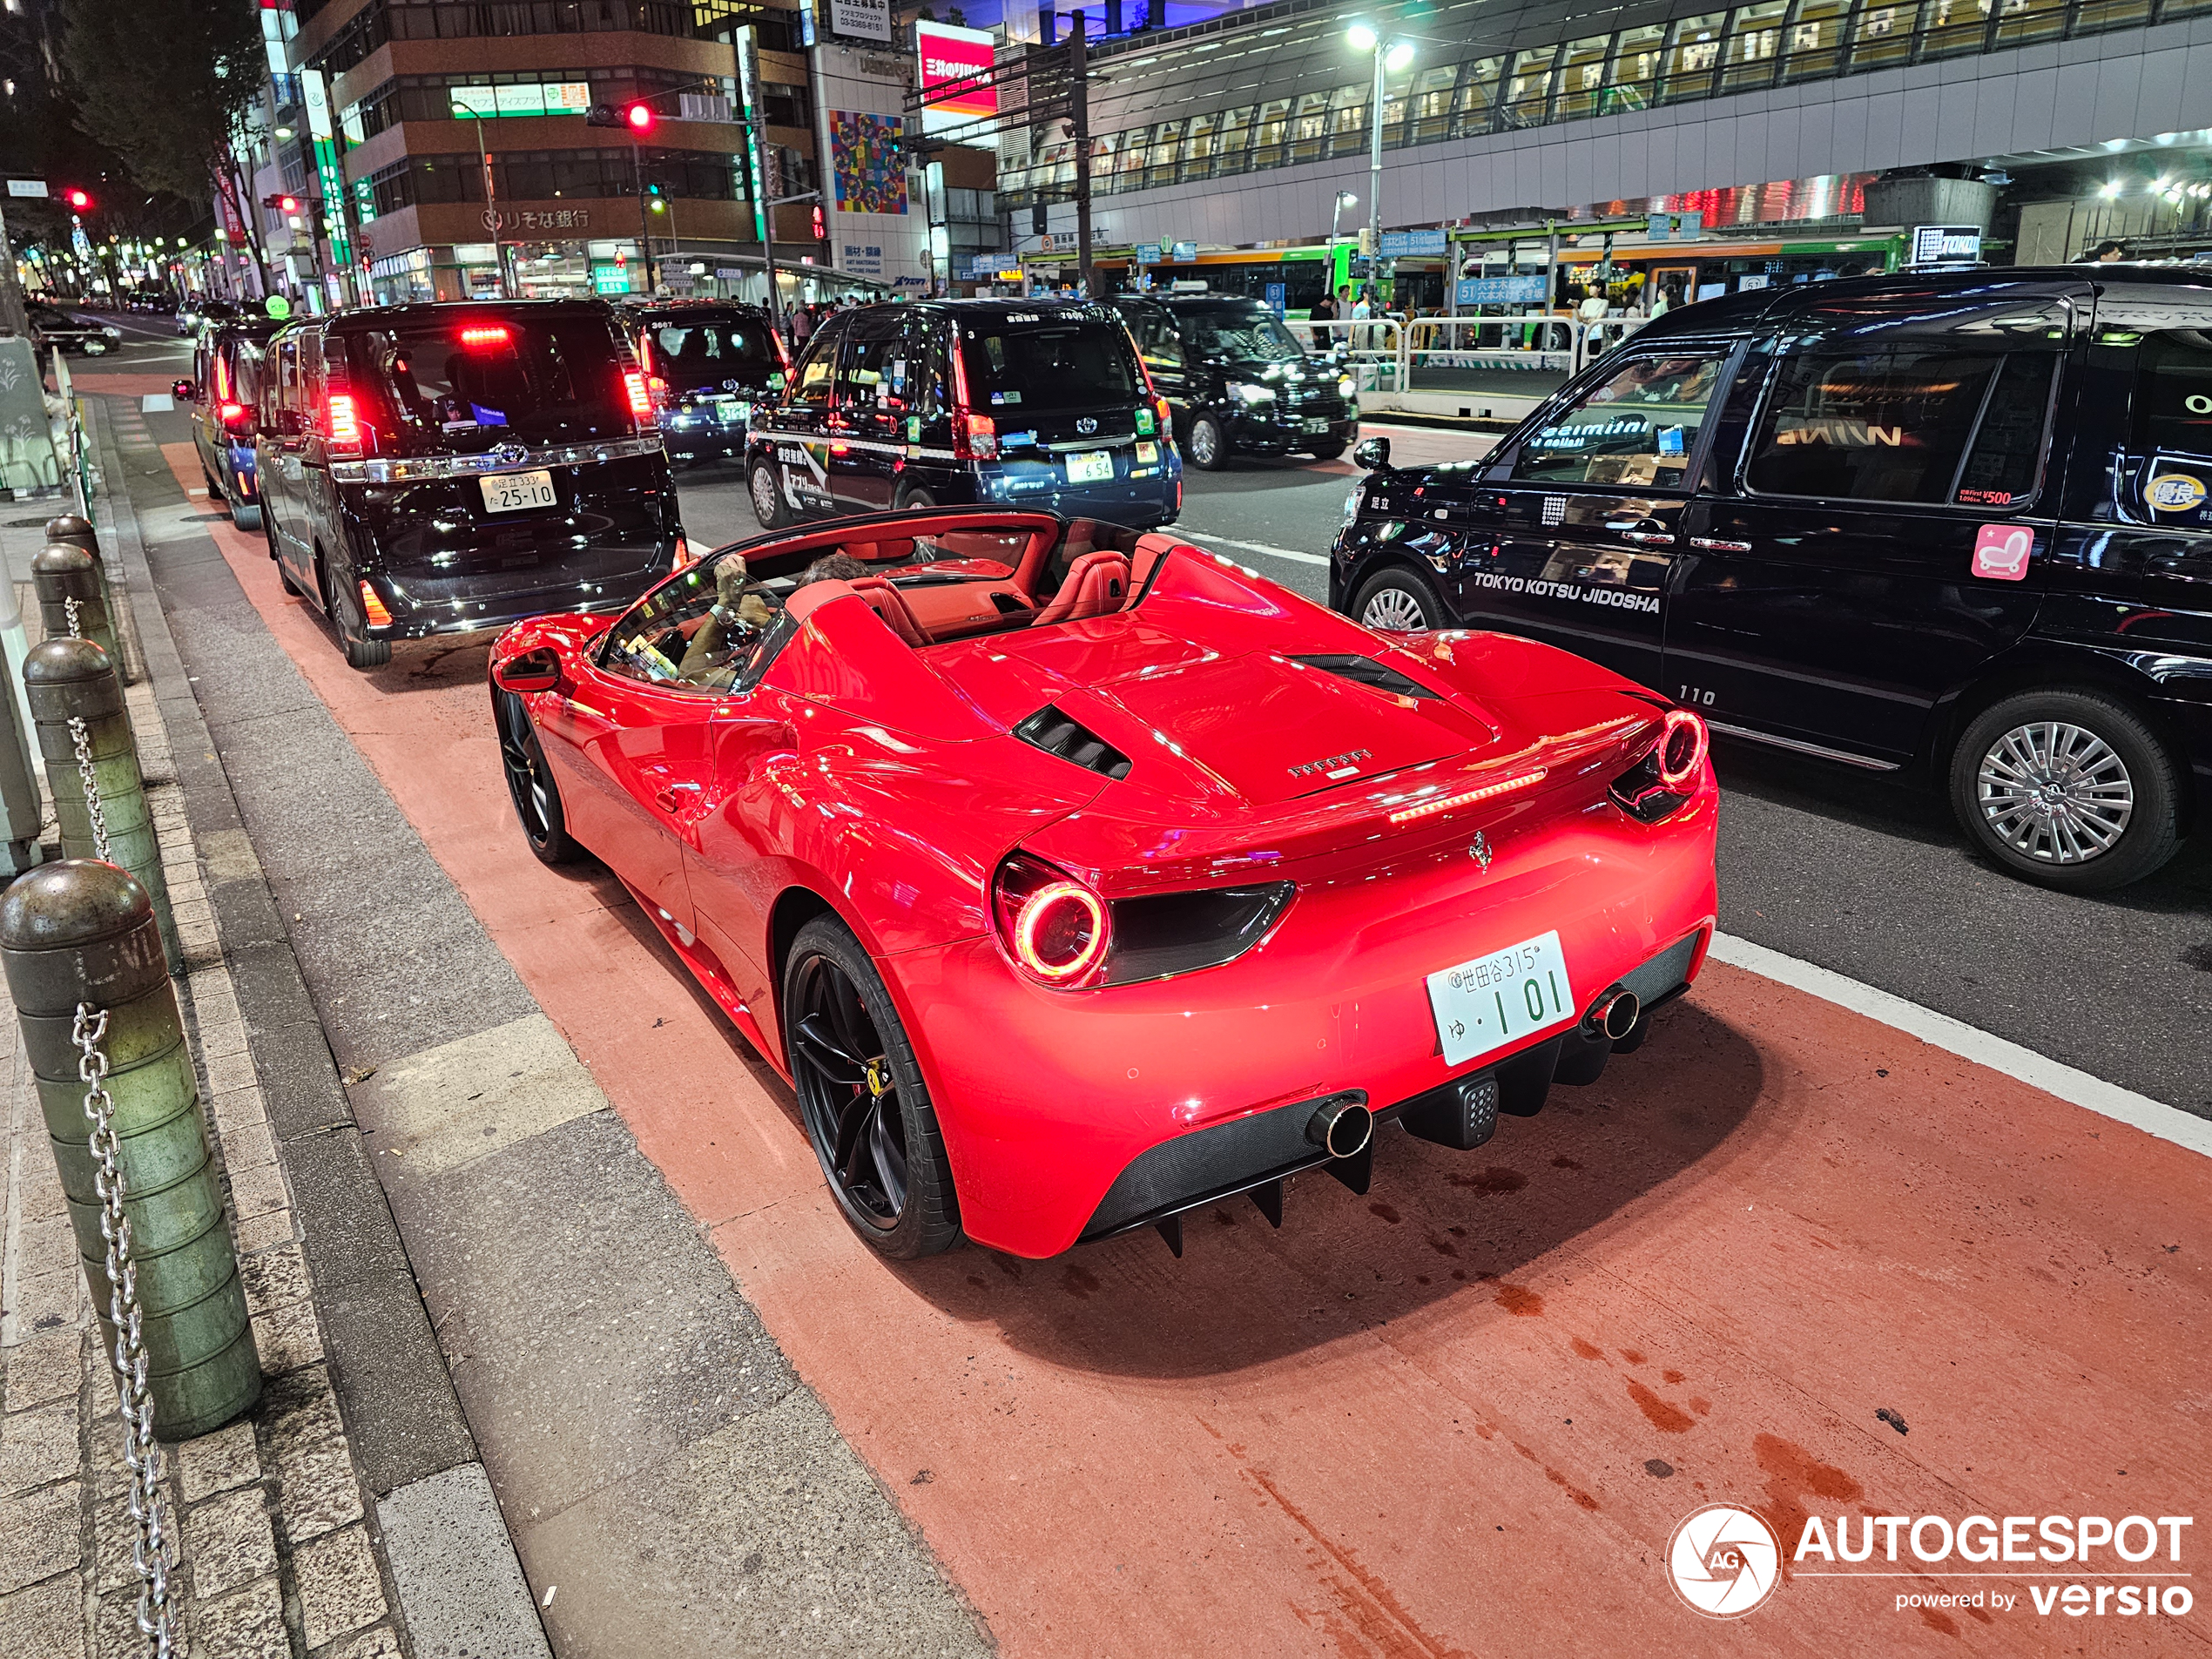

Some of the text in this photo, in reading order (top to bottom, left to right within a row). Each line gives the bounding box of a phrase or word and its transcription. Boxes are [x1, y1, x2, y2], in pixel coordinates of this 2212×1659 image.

[507, 210, 589, 230] りそな銀行
[1461, 286, 1476, 299] 51
[1477, 288, 1545, 301] 六本木けやき坂
[968, 331, 975, 340] 3
[499, 486, 552, 508] 25-10
[1983, 490, 2012, 505] ¥500
[2154, 481, 2195, 504] 優良
[1371, 496, 1390, 510] 足立
[1474, 571, 1660, 614] TOKYO KOTSU JIDOSHA
[1287, 748, 1374, 779] Ferrari
[1447, 1019, 1465, 1042] ゆ
